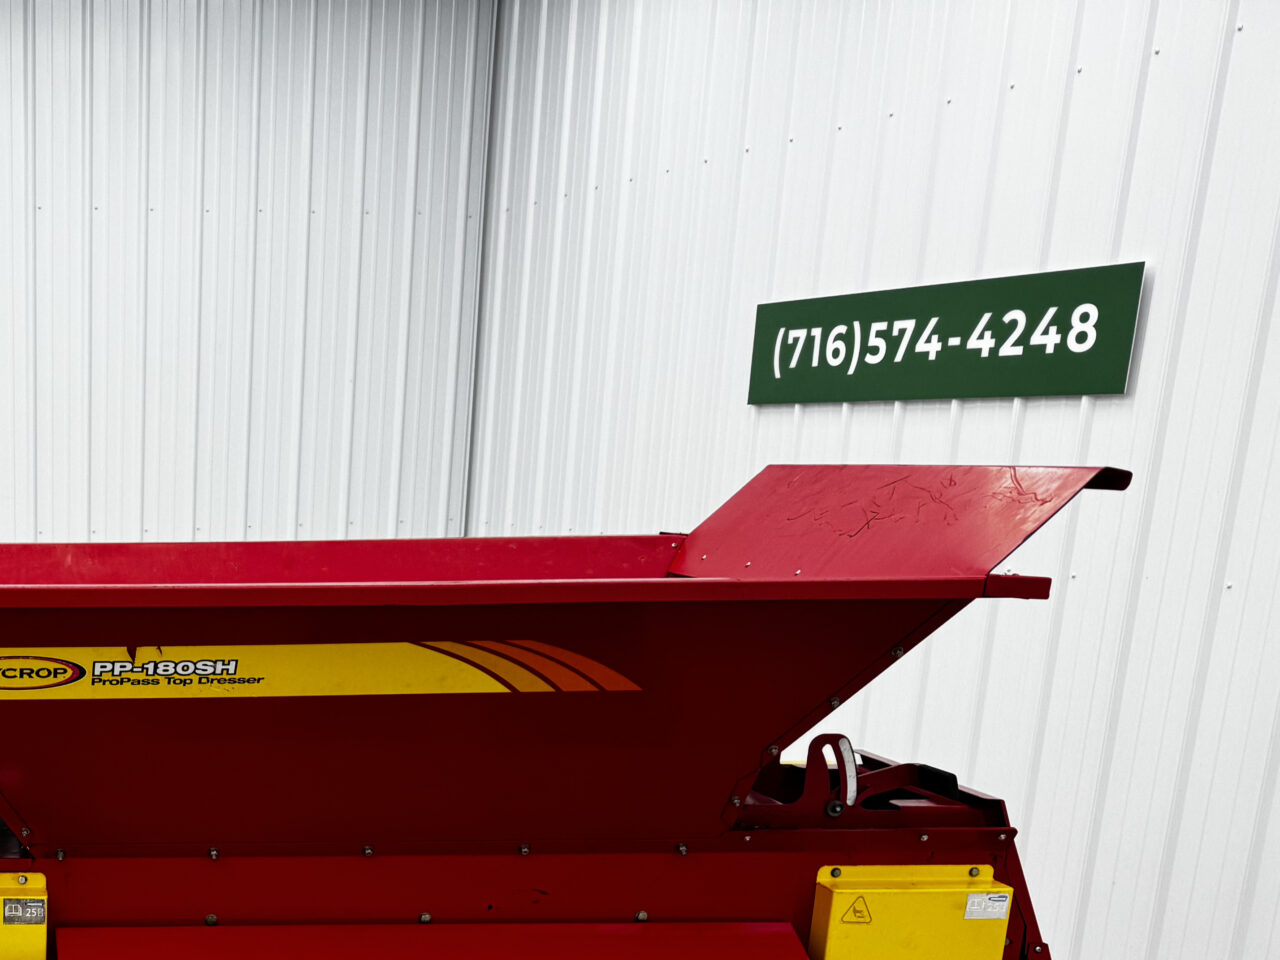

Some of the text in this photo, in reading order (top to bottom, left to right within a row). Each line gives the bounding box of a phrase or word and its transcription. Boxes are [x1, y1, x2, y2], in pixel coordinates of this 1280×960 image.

[773, 302, 1099, 379] (716)574-4248
[92, 659, 239, 677] PP-180SH
[91, 676, 265, 687] ProPass Top Dresser
